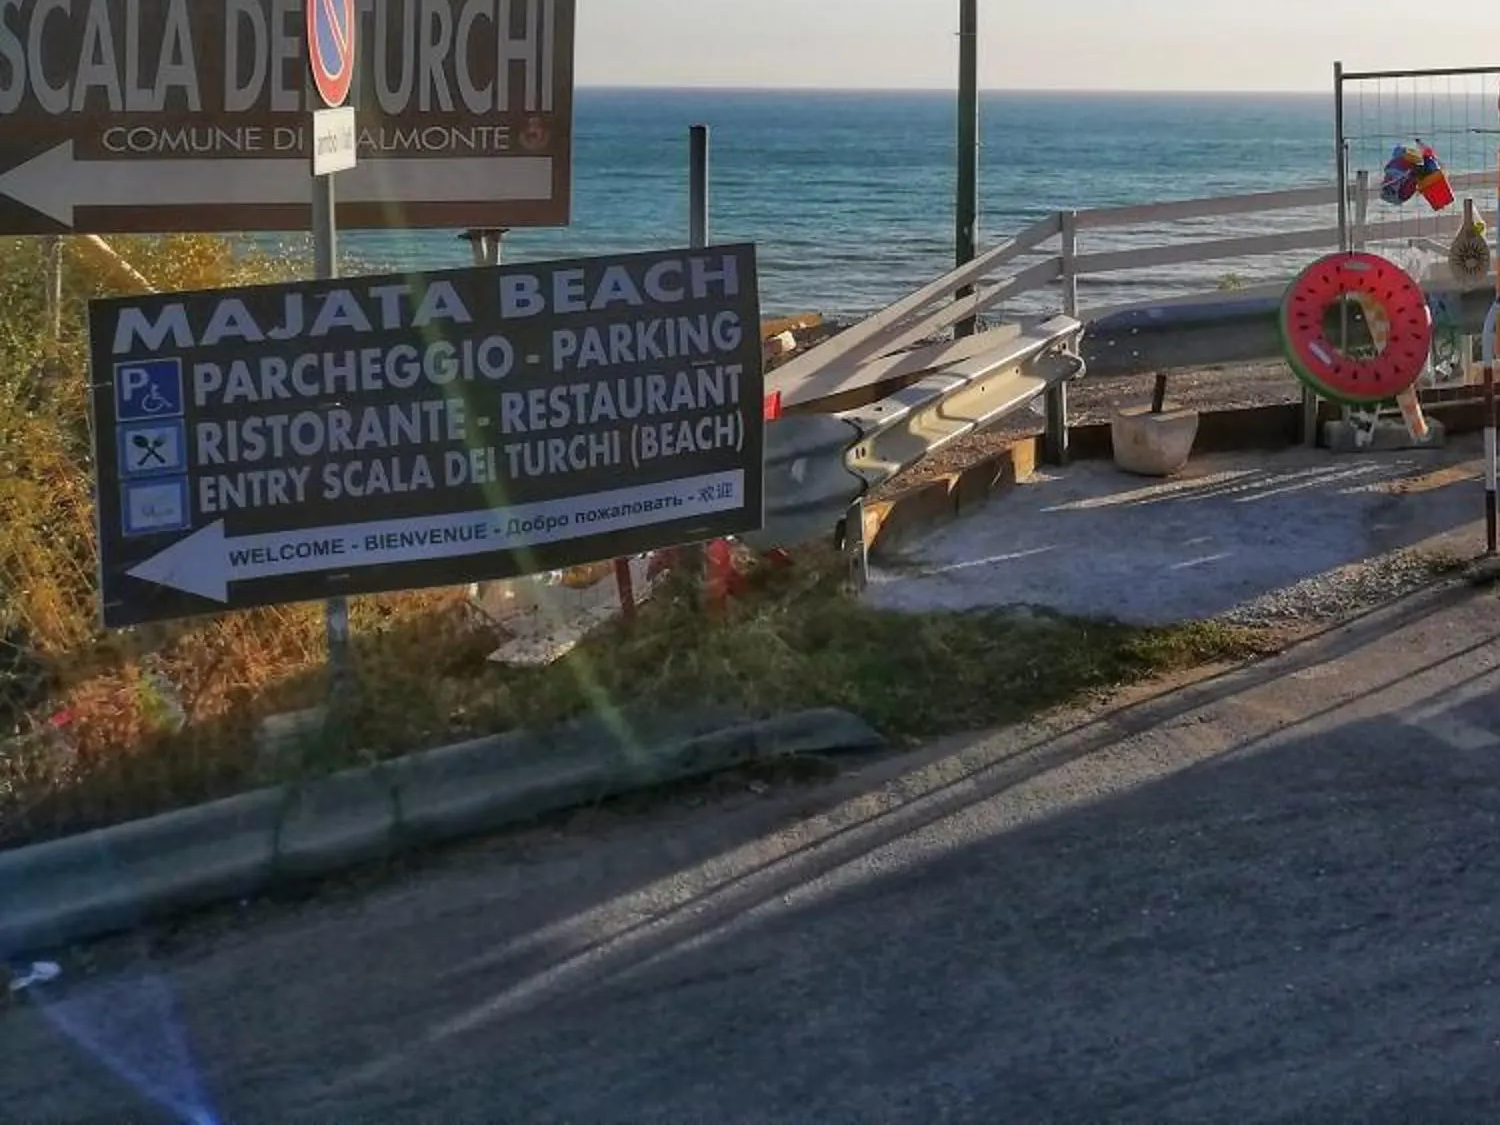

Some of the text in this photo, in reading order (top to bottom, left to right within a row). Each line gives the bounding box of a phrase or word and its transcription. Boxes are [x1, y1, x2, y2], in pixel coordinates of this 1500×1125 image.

[103, 125, 262, 153] COMUNE
[274, 127, 304, 151] DI
[355, 125, 510, 152] ALMONTE
[112, 254, 739, 355] MAJATA BEACH
[121, 368, 149, 401] P
[192, 335, 514, 407] PARCHEGGIO
[551, 309, 742, 371] PARKING
[197, 398, 465, 466] RISTORANTE
[501, 365, 743, 435] RESTAURANT
[199, 414, 744, 513] ENTRY SCALA DEI TURCHI (BEACH)
[229, 537, 345, 569] WELCOME
[365, 521, 487, 553] BIENVENUE
